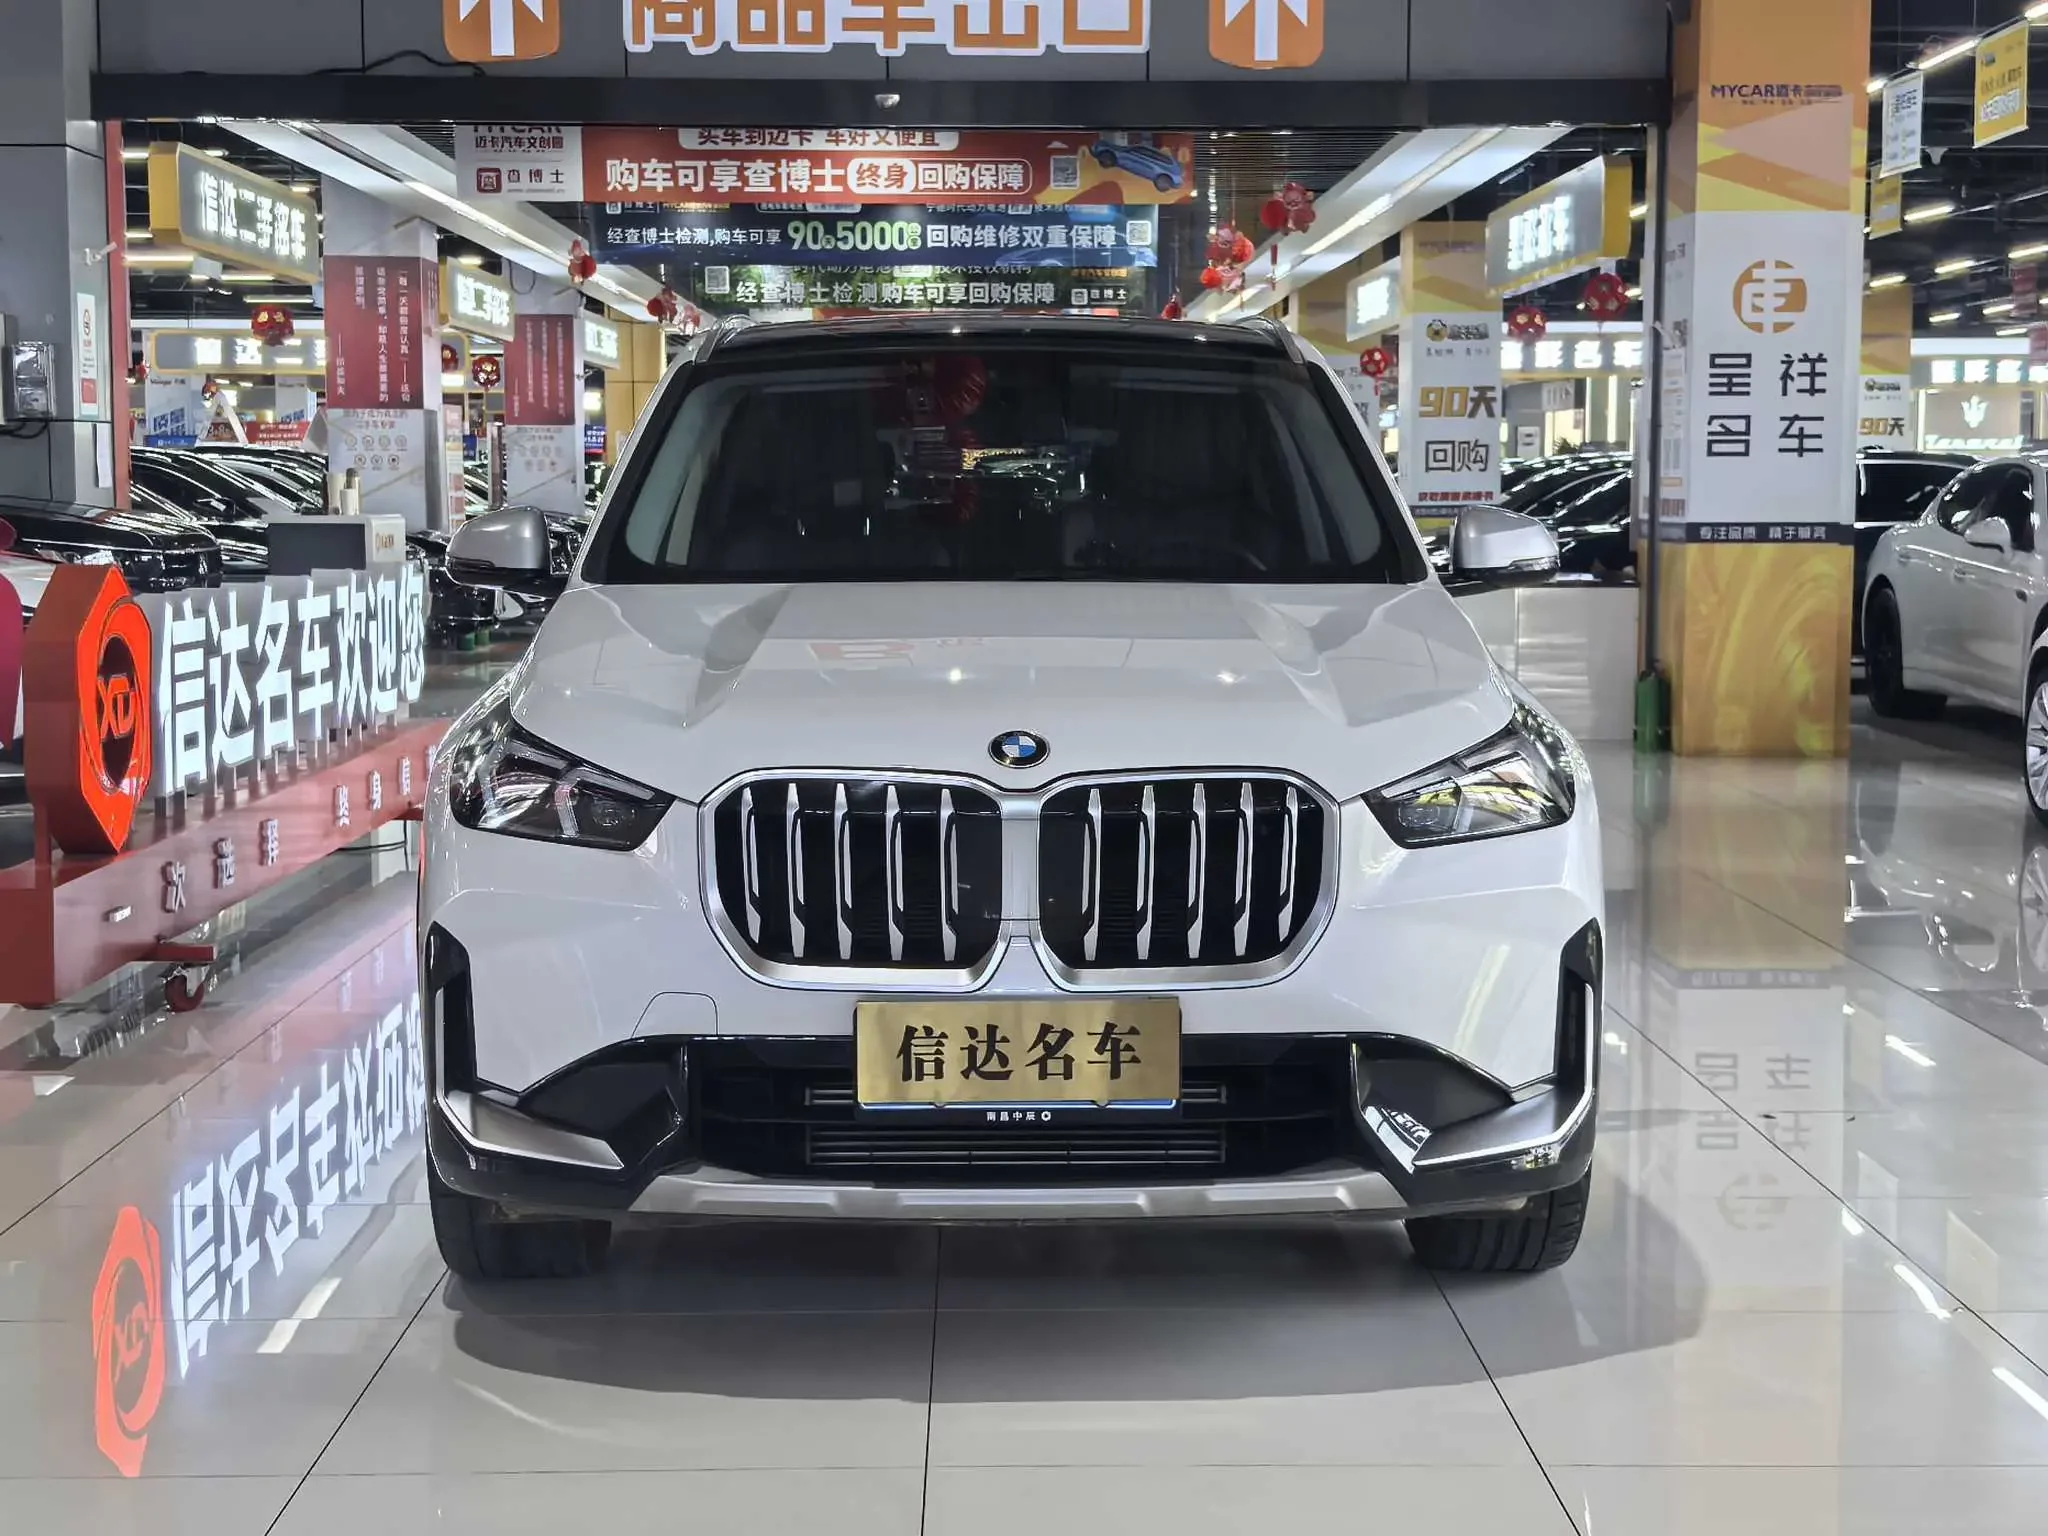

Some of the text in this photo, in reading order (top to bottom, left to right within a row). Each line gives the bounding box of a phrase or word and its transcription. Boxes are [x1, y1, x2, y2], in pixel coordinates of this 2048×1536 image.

[926, 224, 1117, 249] 回购维修双重保障
[1418, 386, 1498, 419] 90天
[1425, 439, 1490, 473] 回购
[160, 563, 425, 796] 信达名车欢迎您
[896, 1021, 1142, 1082] 信达名车
